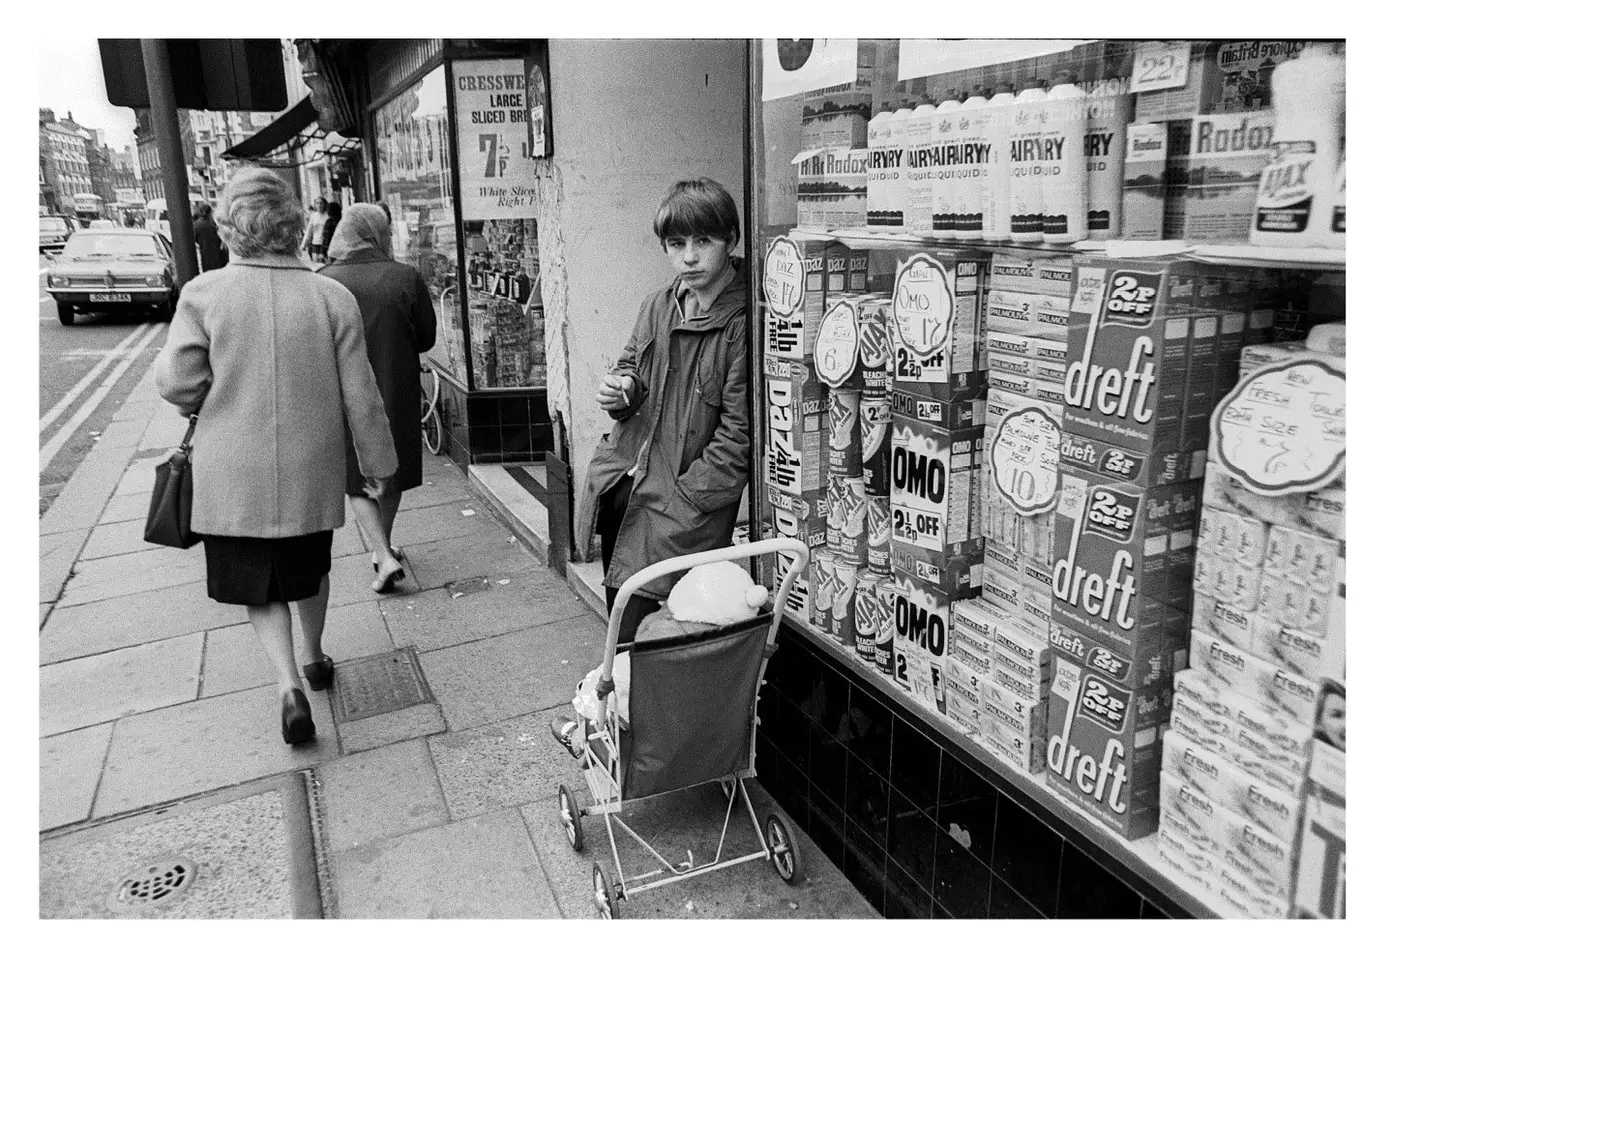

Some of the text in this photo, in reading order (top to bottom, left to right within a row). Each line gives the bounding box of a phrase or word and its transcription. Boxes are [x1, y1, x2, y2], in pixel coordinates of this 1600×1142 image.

[490, 94, 523, 108] LARGE
[472, 111, 506, 124] SLICED
[826, 153, 868, 175] Radox
[479, 187, 508, 197] White
[498, 196, 525, 209] Right
[957, 262, 977, 276] OMO
[1107, 299, 1154, 315] OFF
[769, 321, 778, 353] FREE
[1064, 295, 1156, 424] dreft
[892, 391, 914, 415] OMO
[930, 402, 941, 414] OFF
[952, 439, 972, 454] OMO
[1061, 439, 1096, 464] dreft
[893, 445, 946, 504] OMO
[916, 513, 940, 537] OFF
[1089, 510, 1132, 531] OFF
[1052, 505, 1136, 630] dreft
[895, 593, 945, 657] OMO
[1214, 600, 1248, 627] Fresh
[1050, 629, 1084, 657] dreft
[1210, 641, 1245, 669] Fresh
[1279, 629, 1321, 655] Fresh
[1273, 669, 1316, 700] Fresh
[1083, 696, 1123, 721] OFF
[1047, 710, 1127, 814] dreft
[1184, 747, 1219, 779] Fresh
[1180, 784, 1213, 815] Fresh
[1248, 784, 1290, 817] Fresh
